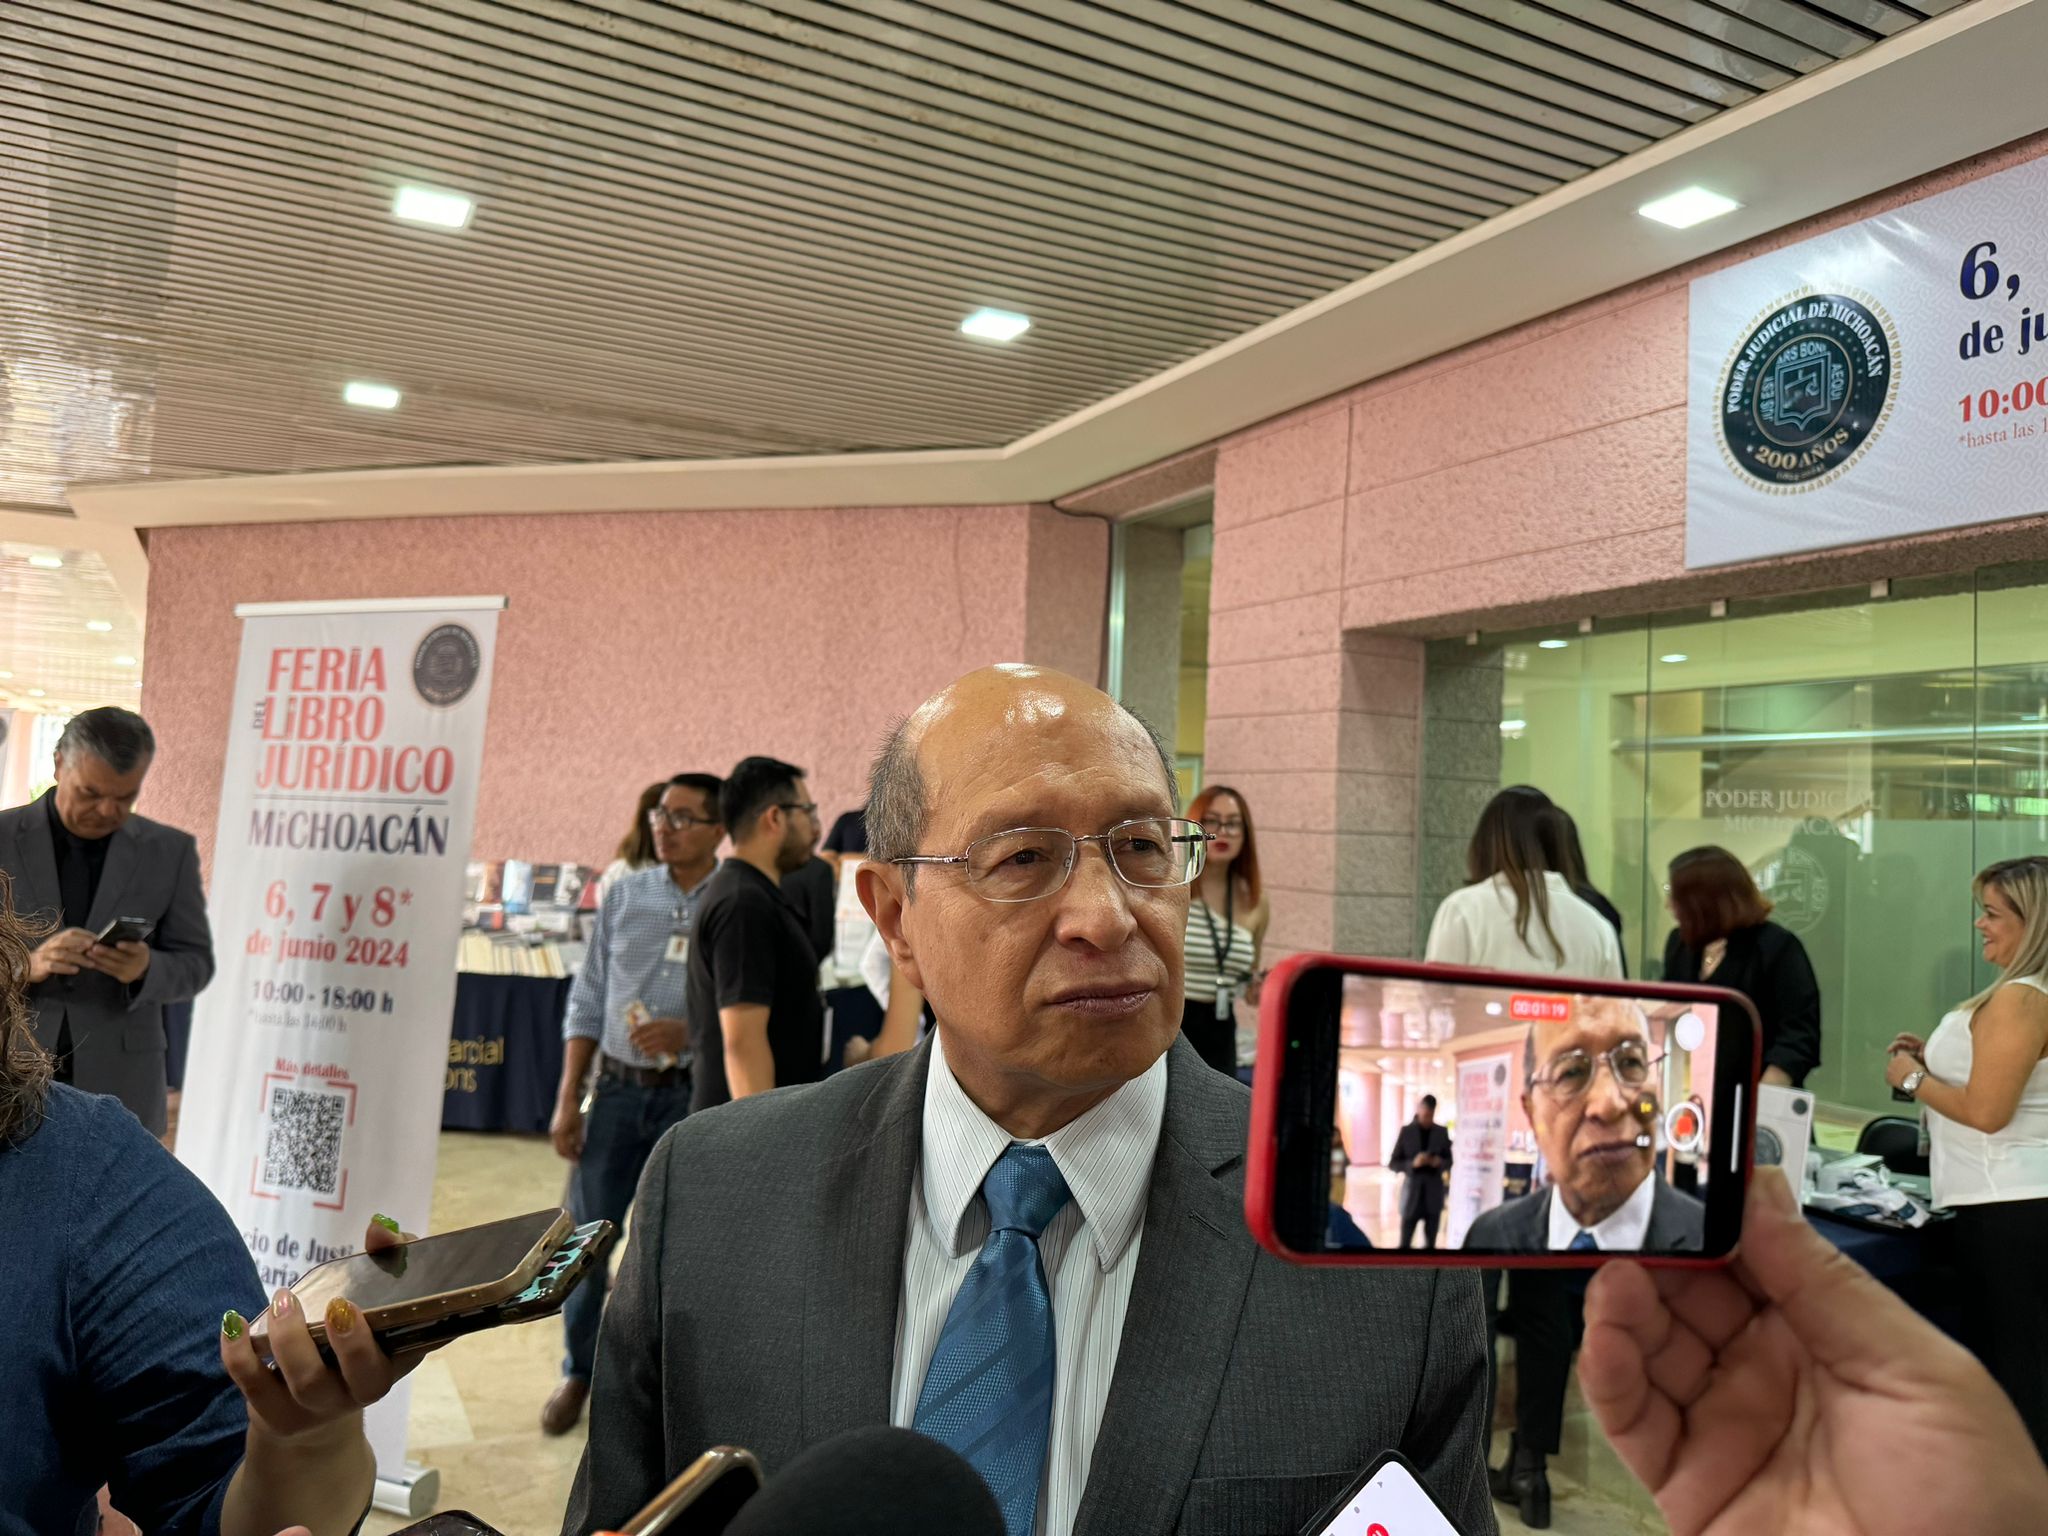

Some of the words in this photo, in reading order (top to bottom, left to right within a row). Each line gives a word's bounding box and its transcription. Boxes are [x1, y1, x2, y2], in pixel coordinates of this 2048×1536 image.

[1959, 241, 2020, 301] 6,
[1727, 359, 1751, 414] PODER
[1749, 305, 1808, 363] JUDICIAL
[1808, 302, 1829, 319] DE
[1829, 302, 1886, 379] MICHOACÁN
[1959, 319, 2004, 360] de
[1755, 445, 1798, 470] 200
[1799, 427, 1850, 468] AÑOS
[2013, 422, 2035, 440] las
[1705, 789, 1775, 809] PODER
[1777, 789, 1882, 813] JUDICAL
[264, 880, 296, 925] 6,
[310, 883, 333, 921] 7
[340, 894, 362, 933] y
[245, 929, 271, 955] de
[278, 931, 337, 965] junio
[344, 936, 410, 968] 2024
[254, 980, 304, 1005] 10:00
[321, 985, 375, 1012] 18:00
[381, 991, 394, 1014] h
[303, 1061, 349, 1080] detalles
[276, 1232, 300, 1259] de
